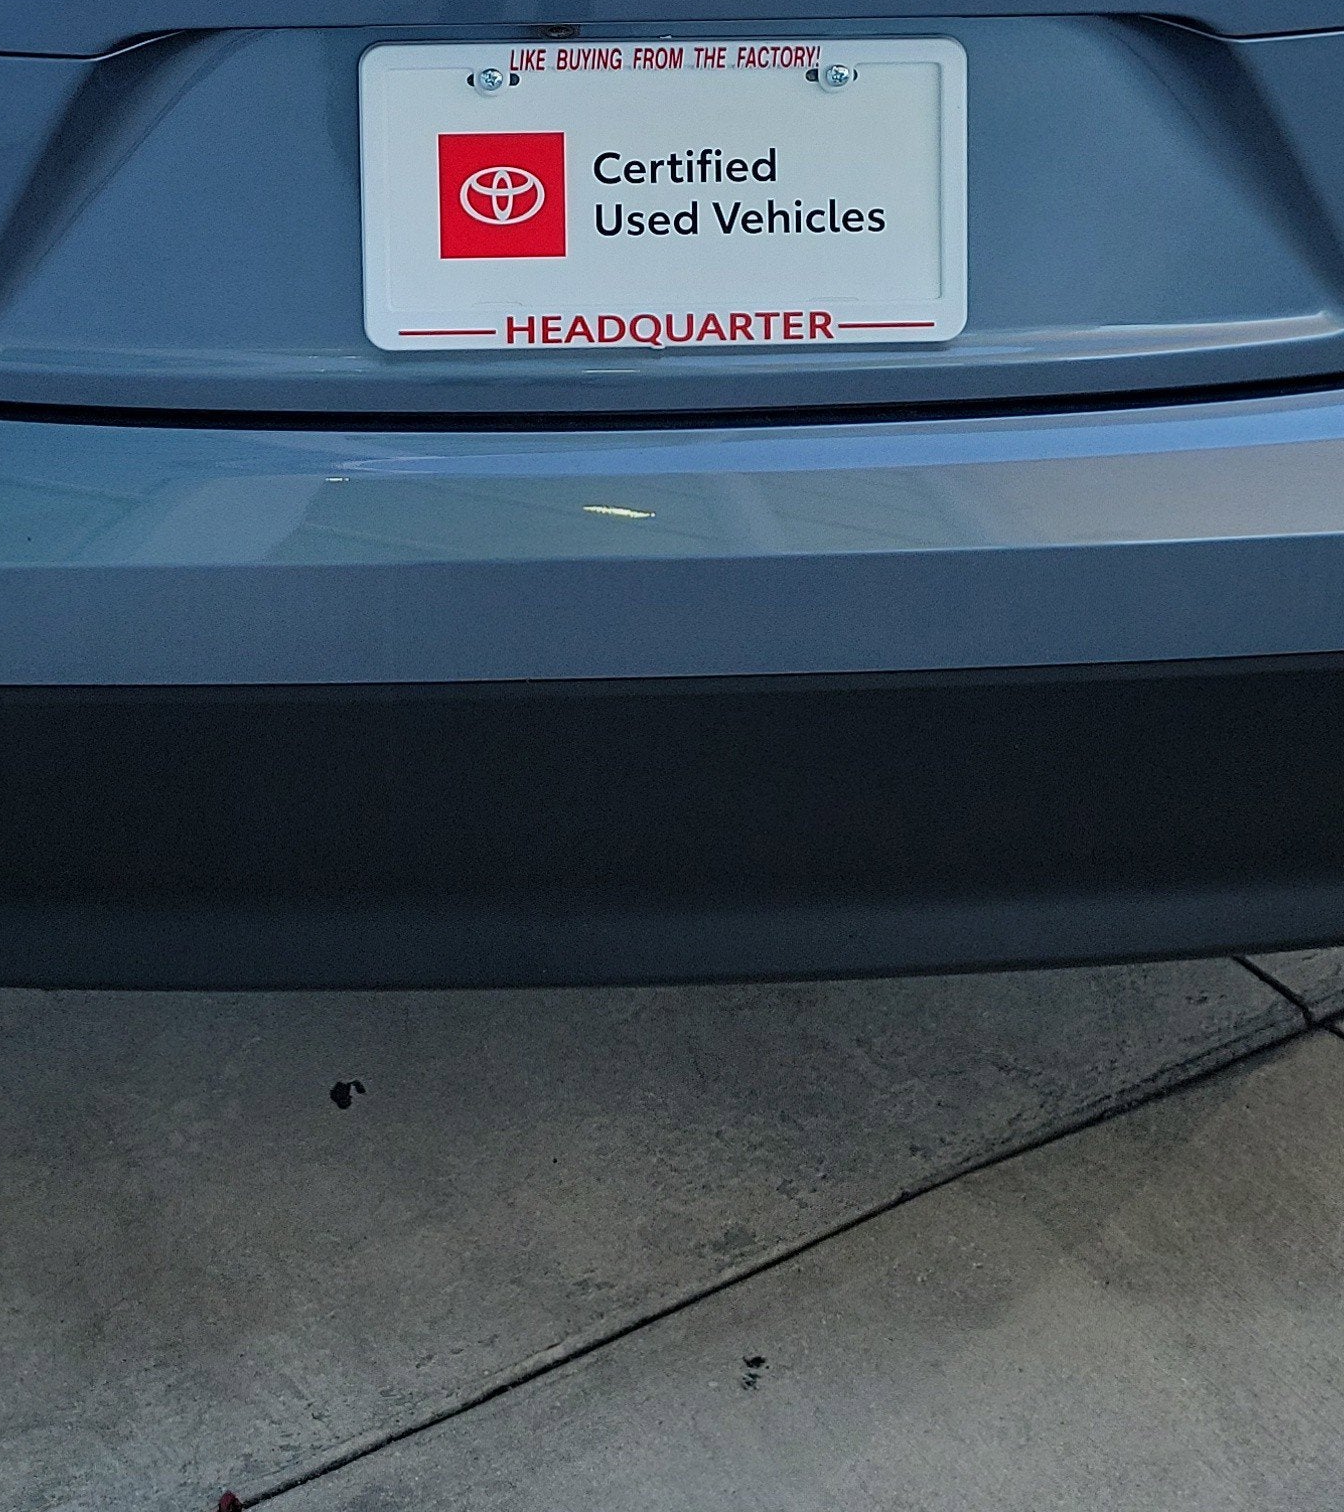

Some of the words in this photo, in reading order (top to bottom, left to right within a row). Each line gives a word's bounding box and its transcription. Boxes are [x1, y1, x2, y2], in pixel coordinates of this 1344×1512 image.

[509, 49, 546, 71] LIKE
[556, 48, 623, 70] BUYING
[633, 47, 684, 69] FROM
[694, 46, 727, 68] THE
[737, 45, 821, 68] FACTORY!
[593, 147, 777, 185] Certified
[595, 200, 699, 236] Used
[712, 198, 886, 234] Vehicles
[506, 311, 835, 346] HEADQUARTER
